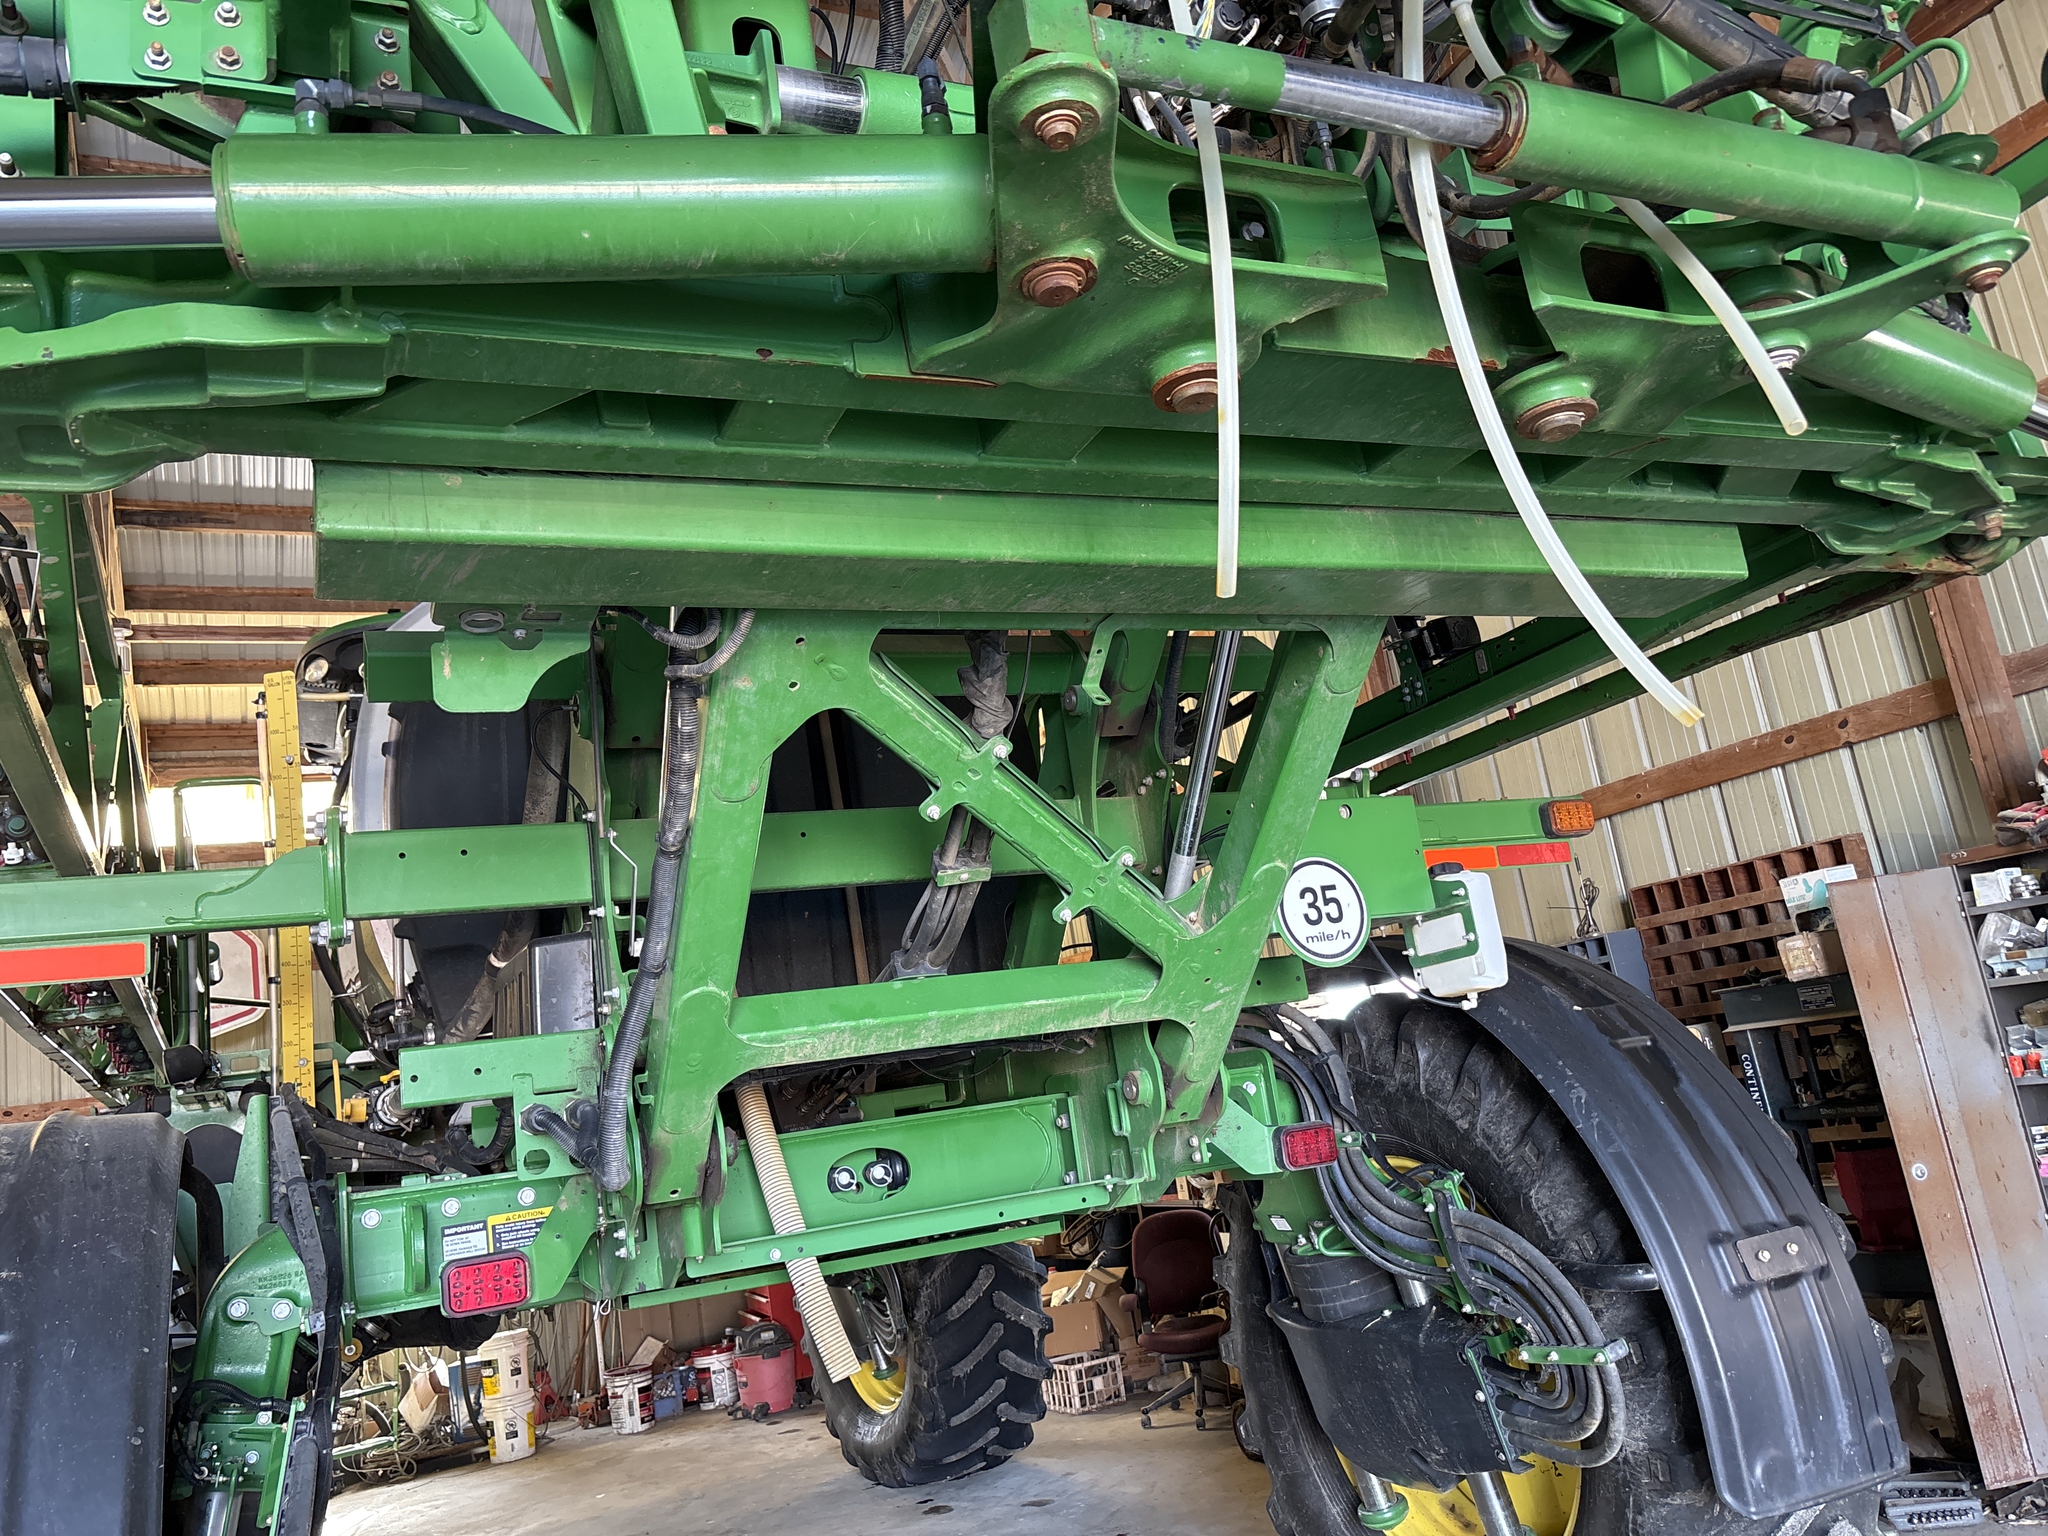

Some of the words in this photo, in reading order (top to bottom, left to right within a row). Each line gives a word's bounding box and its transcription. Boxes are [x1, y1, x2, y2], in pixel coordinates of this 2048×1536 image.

[1299, 884, 1343, 926] 35
[1306, 930, 1351, 943] mile/h
[512, 1210, 545, 1220] CAUTION
[444, 1223, 484, 1235] IMPORTANT
